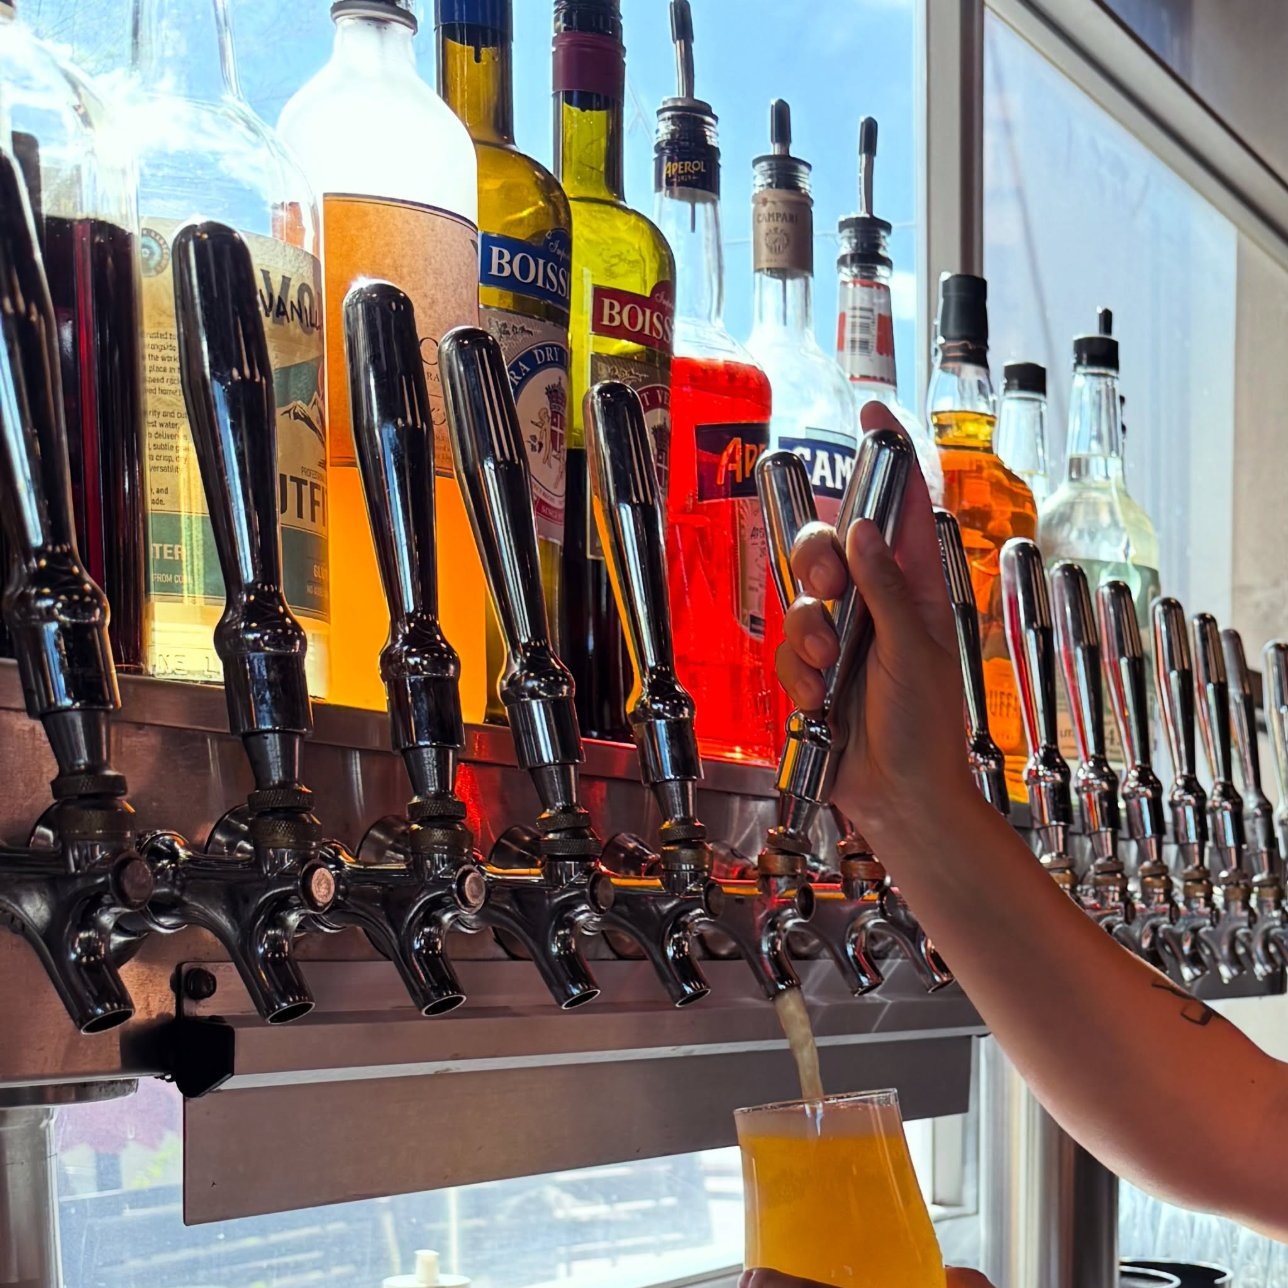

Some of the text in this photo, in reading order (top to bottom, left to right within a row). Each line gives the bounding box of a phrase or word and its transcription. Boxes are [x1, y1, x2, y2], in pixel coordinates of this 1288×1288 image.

[666, 160, 706, 177] APEROL
[756, 212, 799, 224] CAMPARI
[533, 346, 560, 365] DRY
[153, 572, 173, 583] FROM
